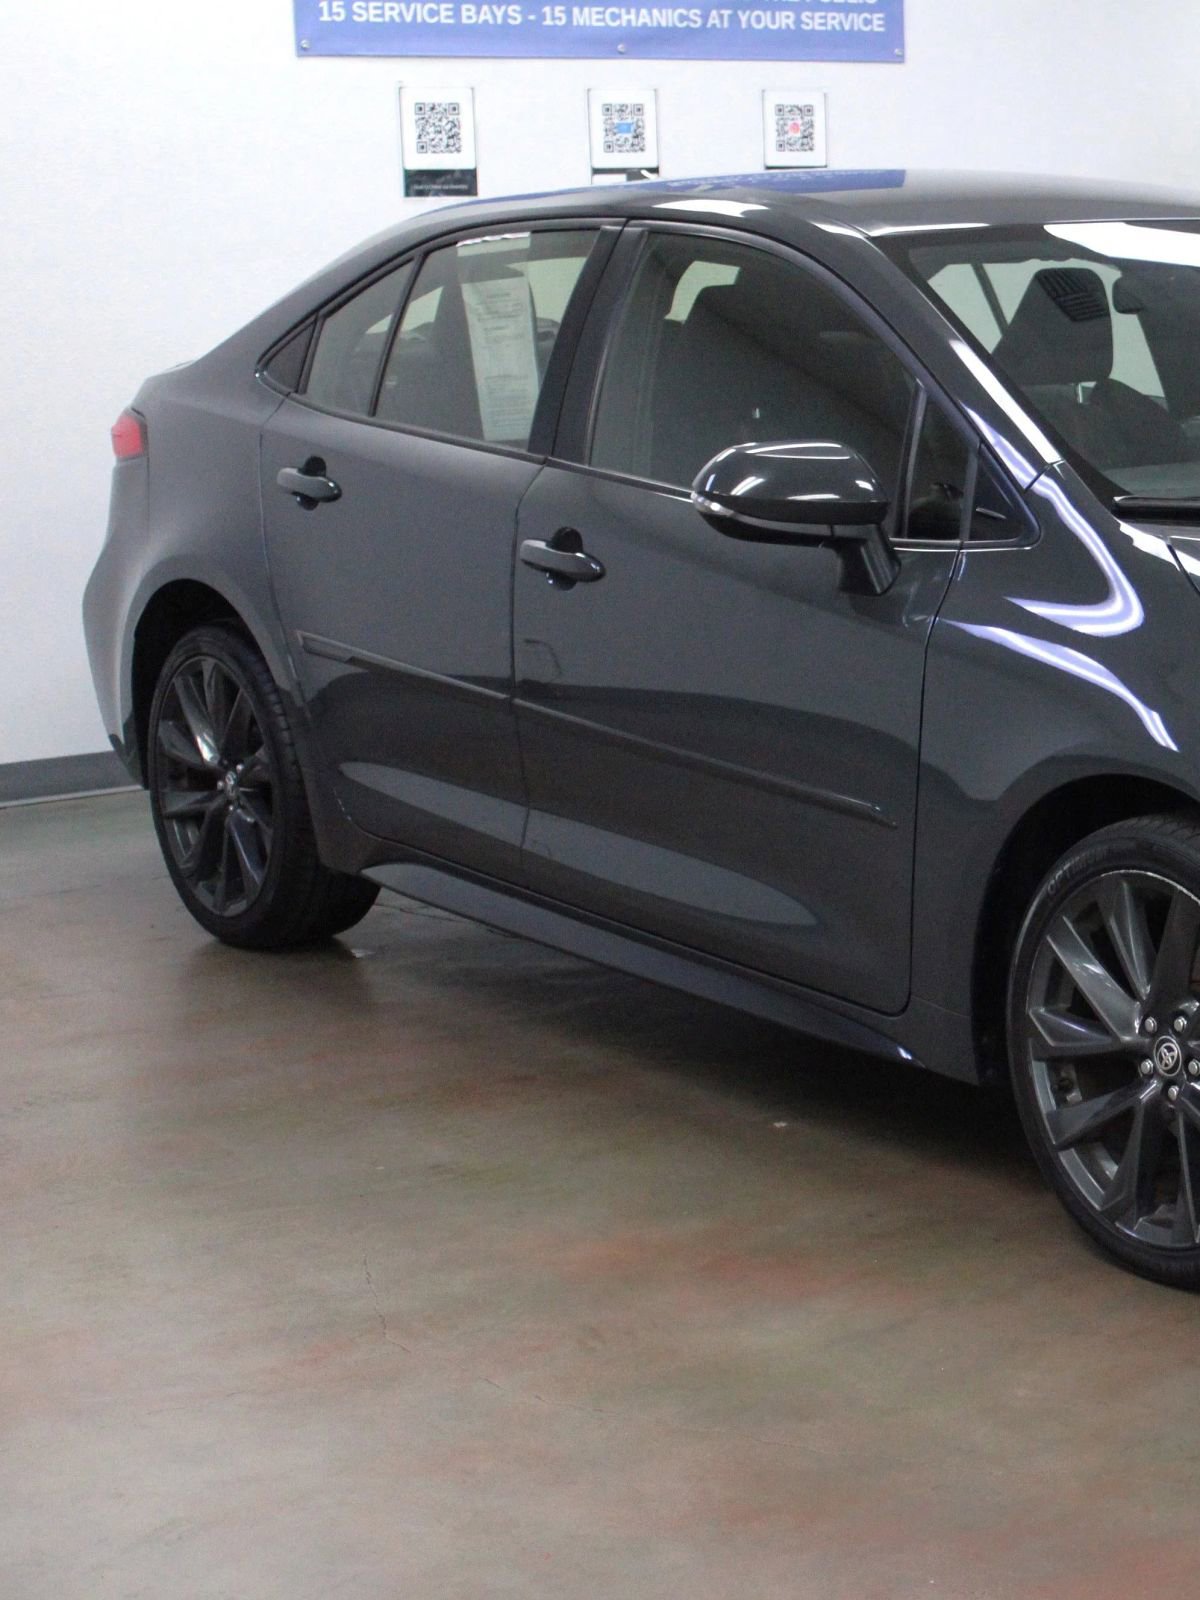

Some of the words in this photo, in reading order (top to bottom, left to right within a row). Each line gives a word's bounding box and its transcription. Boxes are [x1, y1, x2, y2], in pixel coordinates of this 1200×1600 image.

[318, 1, 345, 21] 15
[351, 2, 454, 24] SERVICE
[461, 4, 522, 25] BAYS
[541, 6, 566, 26] 15
[571, 7, 702, 28] MECHANICS
[706, 10, 733, 28] AT
[737, 10, 795, 30] YOUR
[800, 12, 885, 32] SERVICE
